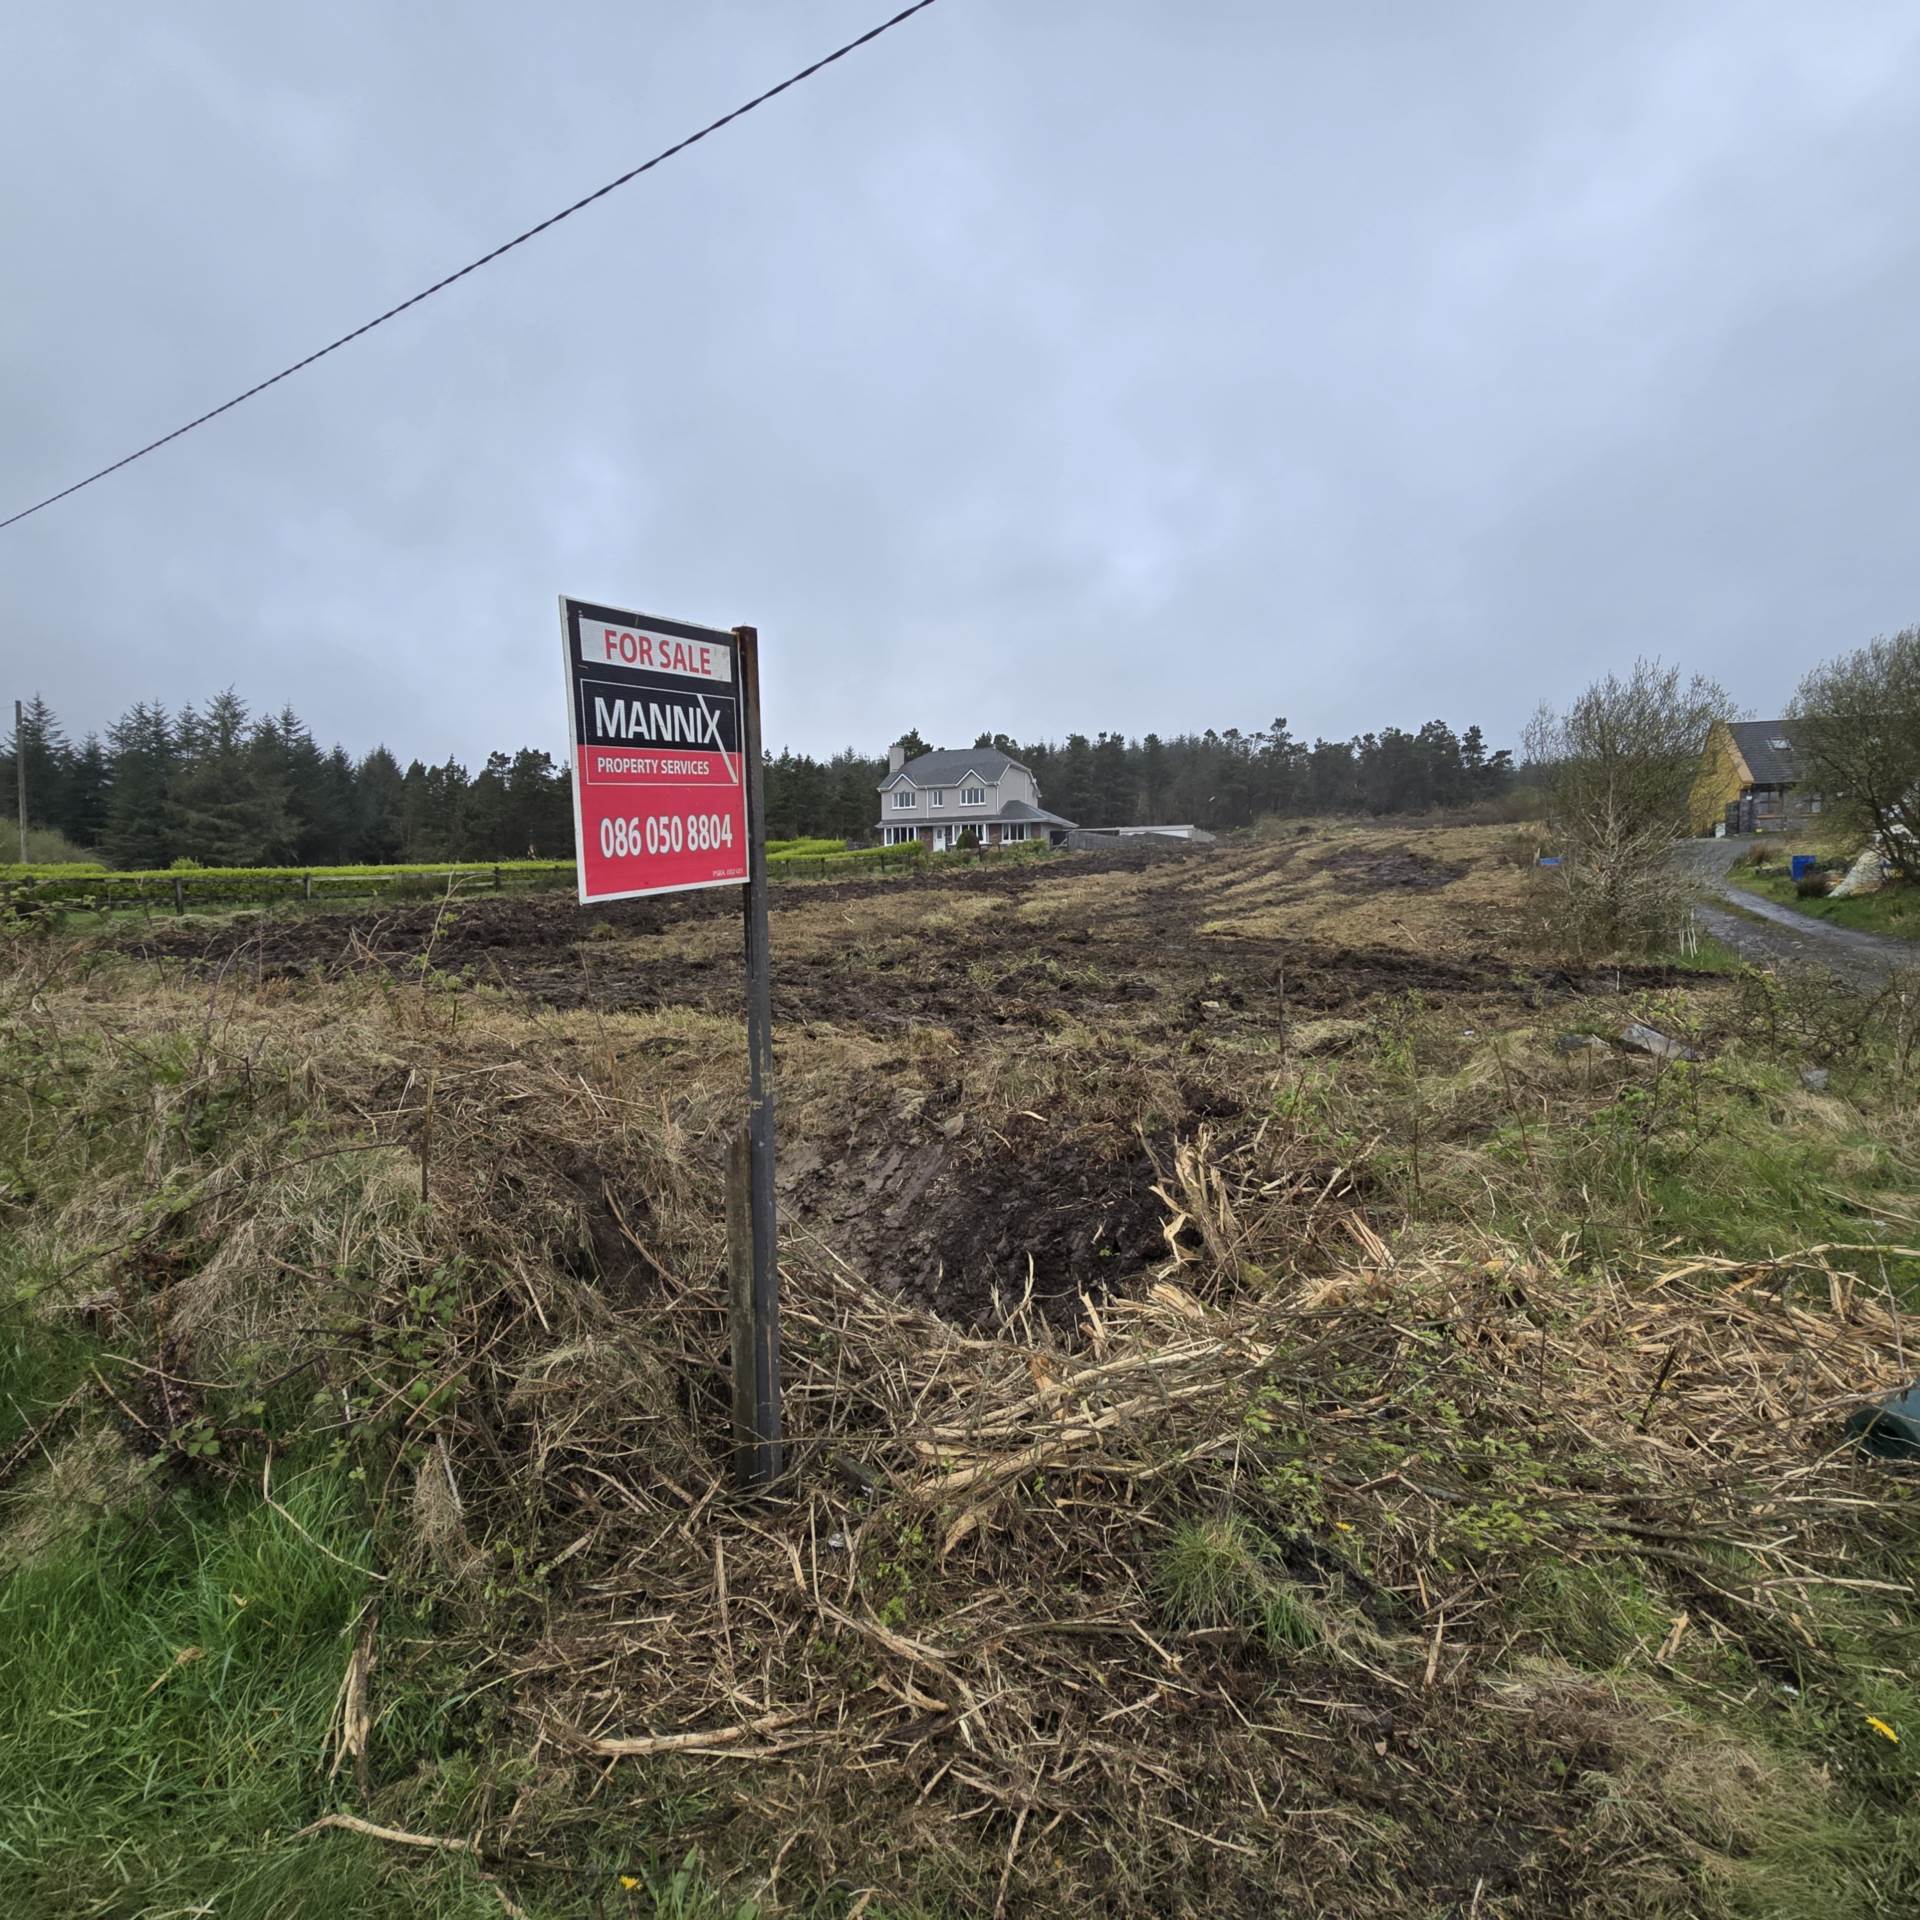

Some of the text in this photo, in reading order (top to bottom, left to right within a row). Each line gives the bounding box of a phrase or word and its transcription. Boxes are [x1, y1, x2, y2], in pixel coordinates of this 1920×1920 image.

[604, 629, 711, 675] FOR SALE
[597, 756, 710, 775] PROPERTY SERVICES
[600, 813, 733, 859] 086 050 8804
